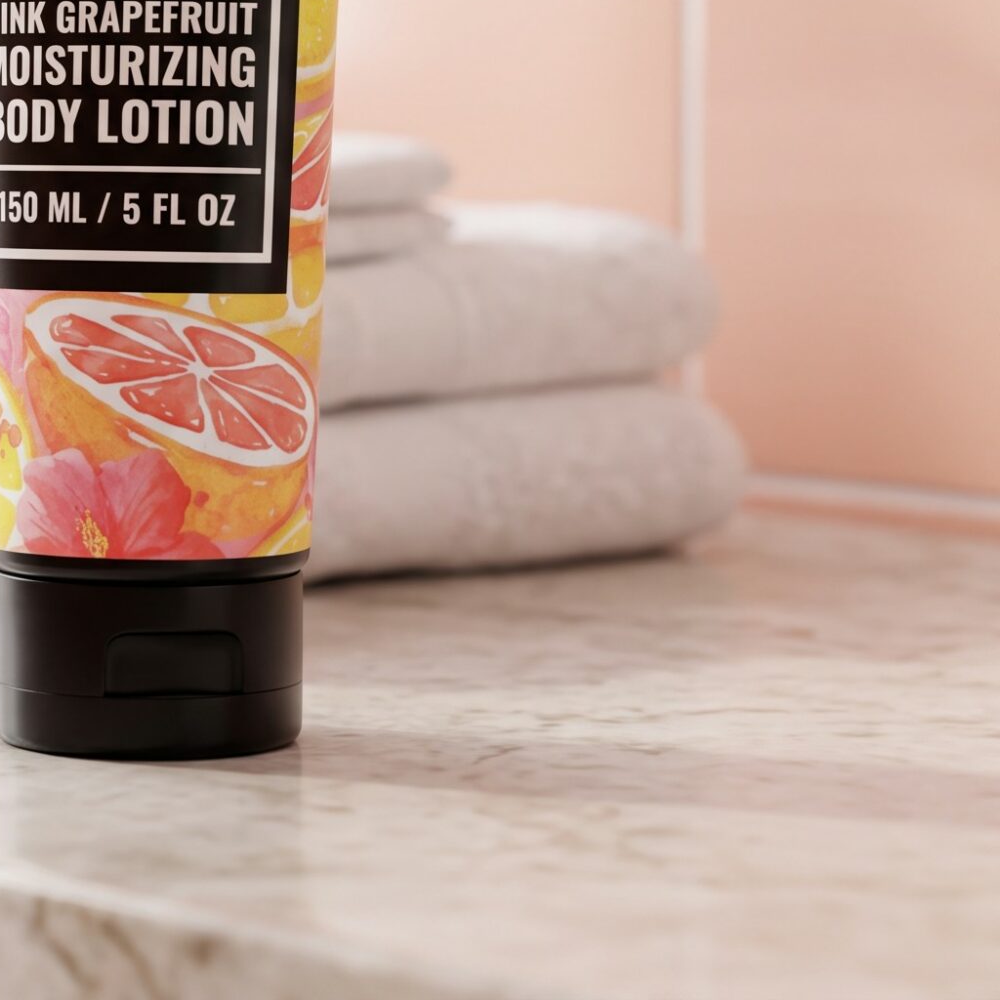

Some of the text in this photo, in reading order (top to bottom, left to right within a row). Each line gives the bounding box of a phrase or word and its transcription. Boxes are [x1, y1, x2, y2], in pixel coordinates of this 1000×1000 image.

[55, 0, 259, 36] GRAPEFRUIT
[97, 98, 256, 147] LOTION
[47, 190, 88, 225] ML
[97, 191, 112, 225] /
[122, 192, 141, 226] 5
[152, 192, 187, 226] FL
[196, 192, 237, 227] OZ
